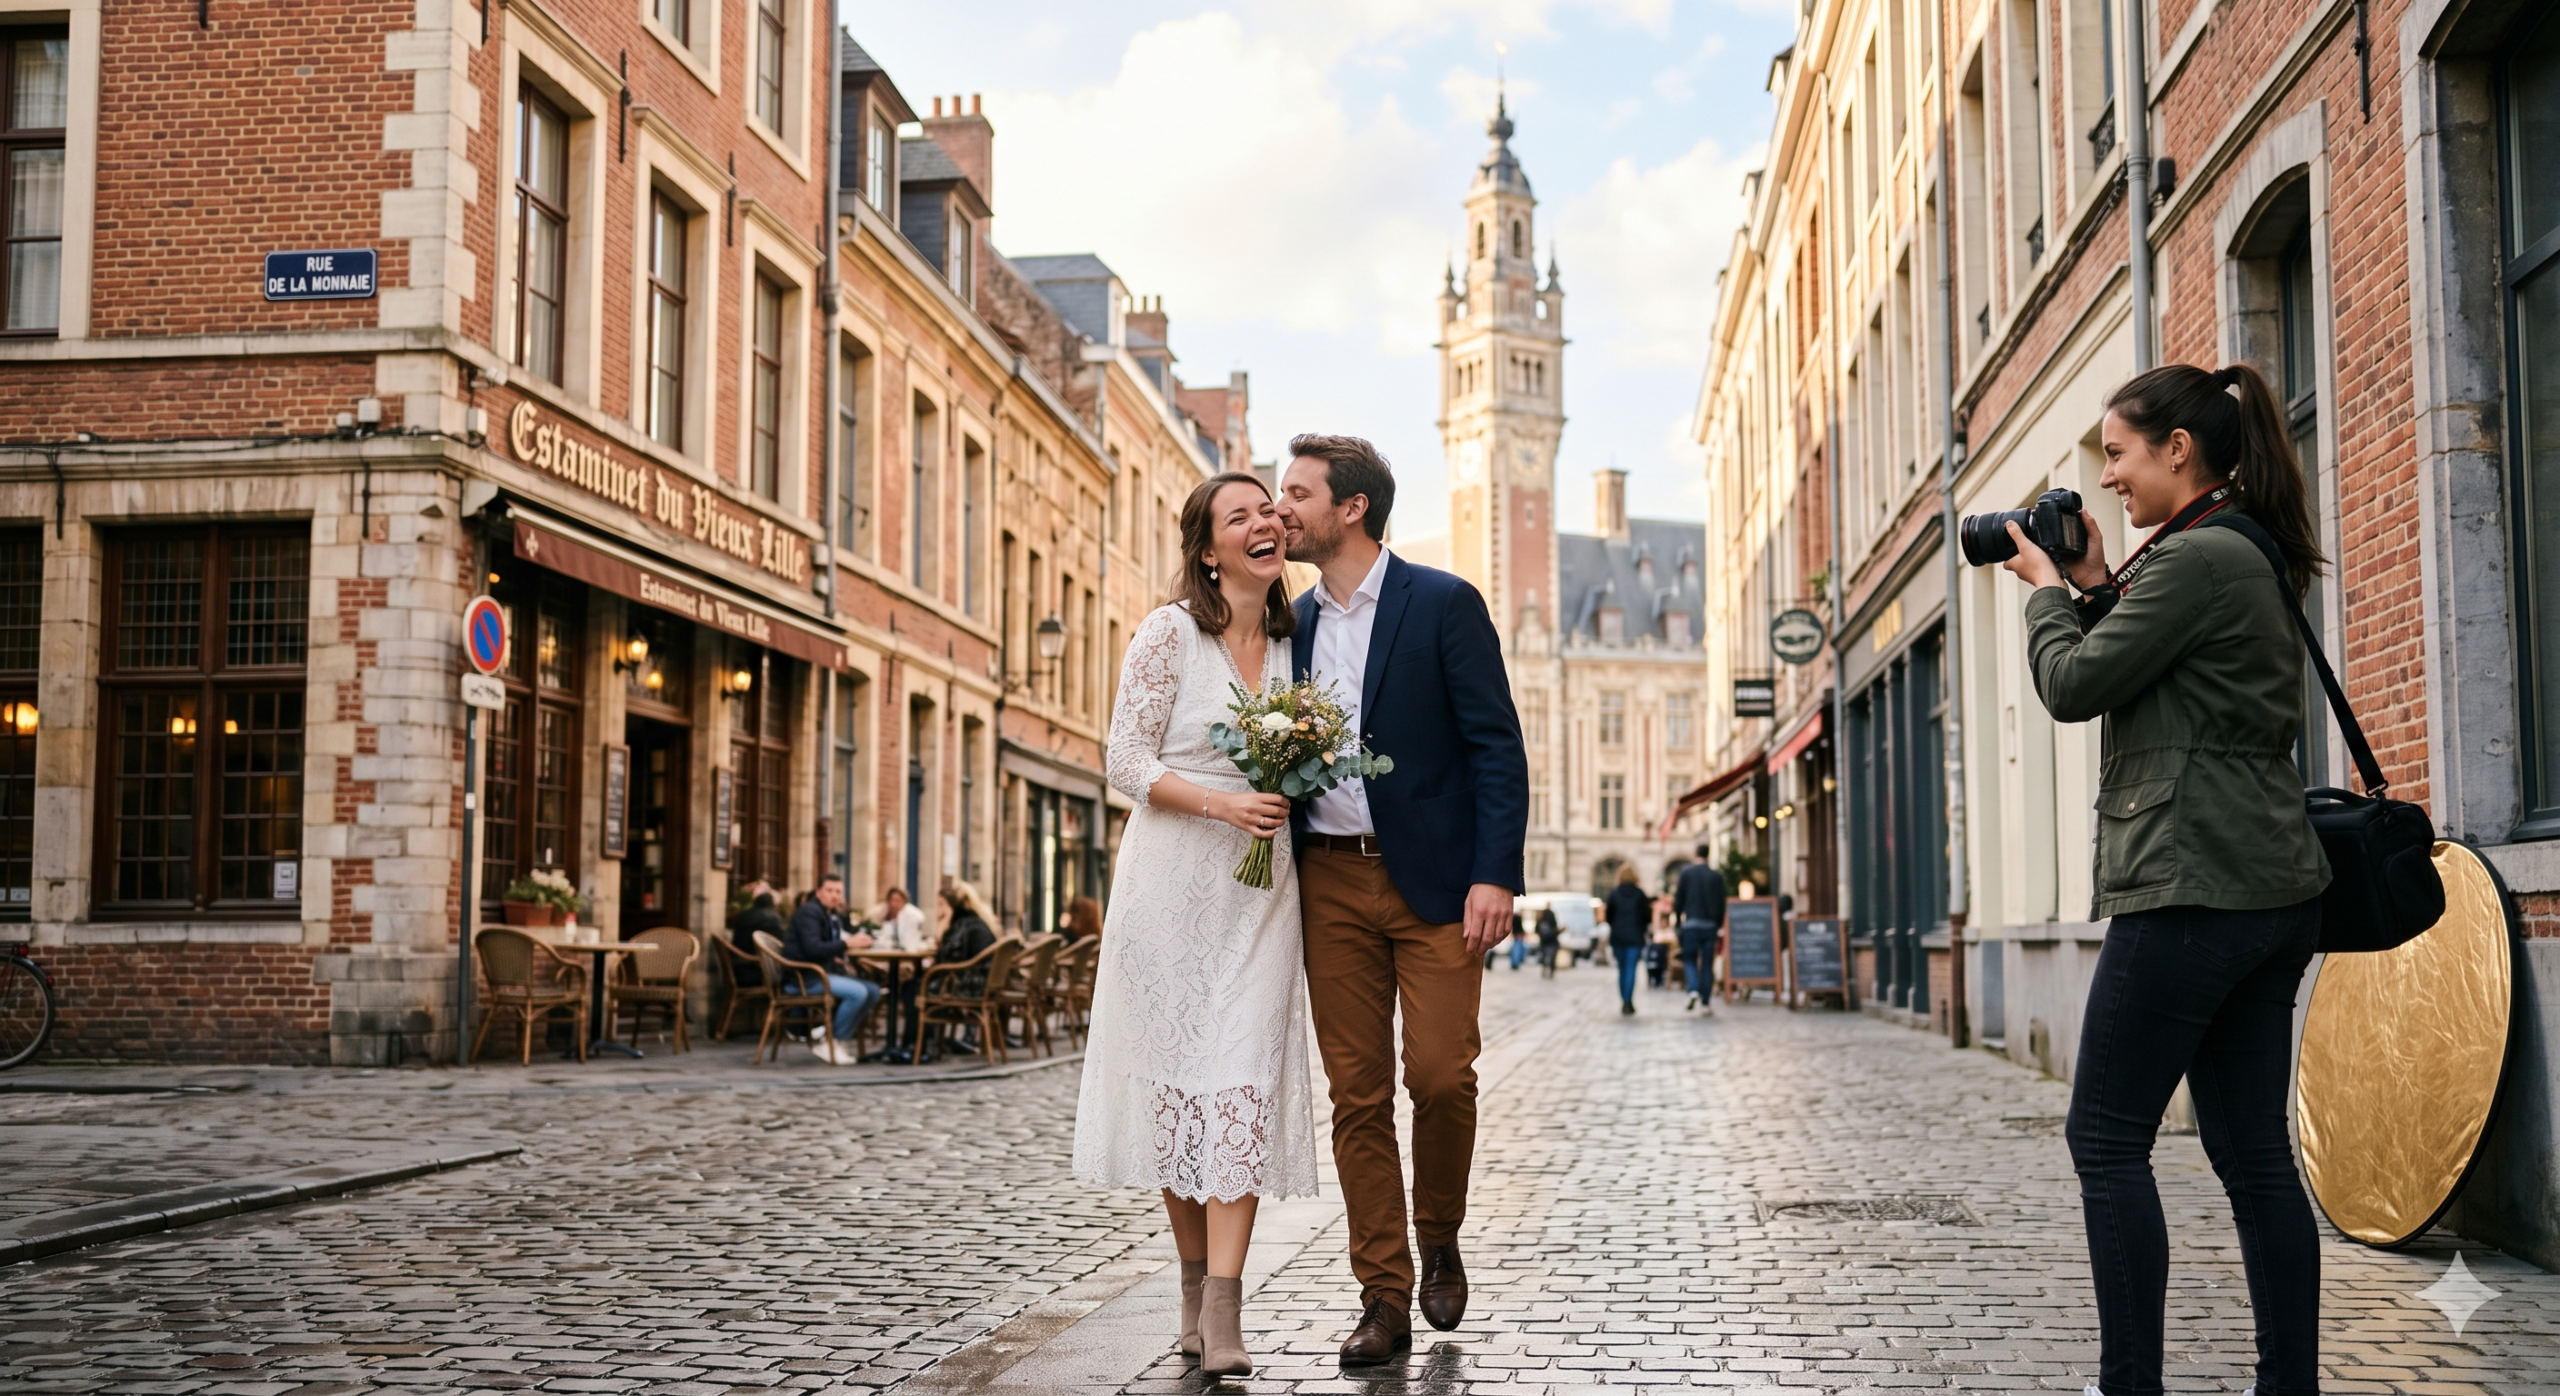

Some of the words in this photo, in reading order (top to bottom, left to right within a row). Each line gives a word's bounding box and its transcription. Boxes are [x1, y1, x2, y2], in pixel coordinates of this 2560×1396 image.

[268, 277, 286, 294] DE
[290, 276, 307, 293] LA
[311, 274, 371, 292] MONNAIE
[306, 256, 334, 272] RUE
[511, 400, 648, 514] Estaminet
[656, 469, 684, 530] du
[692, 484, 755, 561] Vieux
[759, 517, 806, 583] Lille
[640, 572, 697, 617] Estaminet
[716, 600, 747, 634] Vieux
[747, 612, 771, 642] Lille
